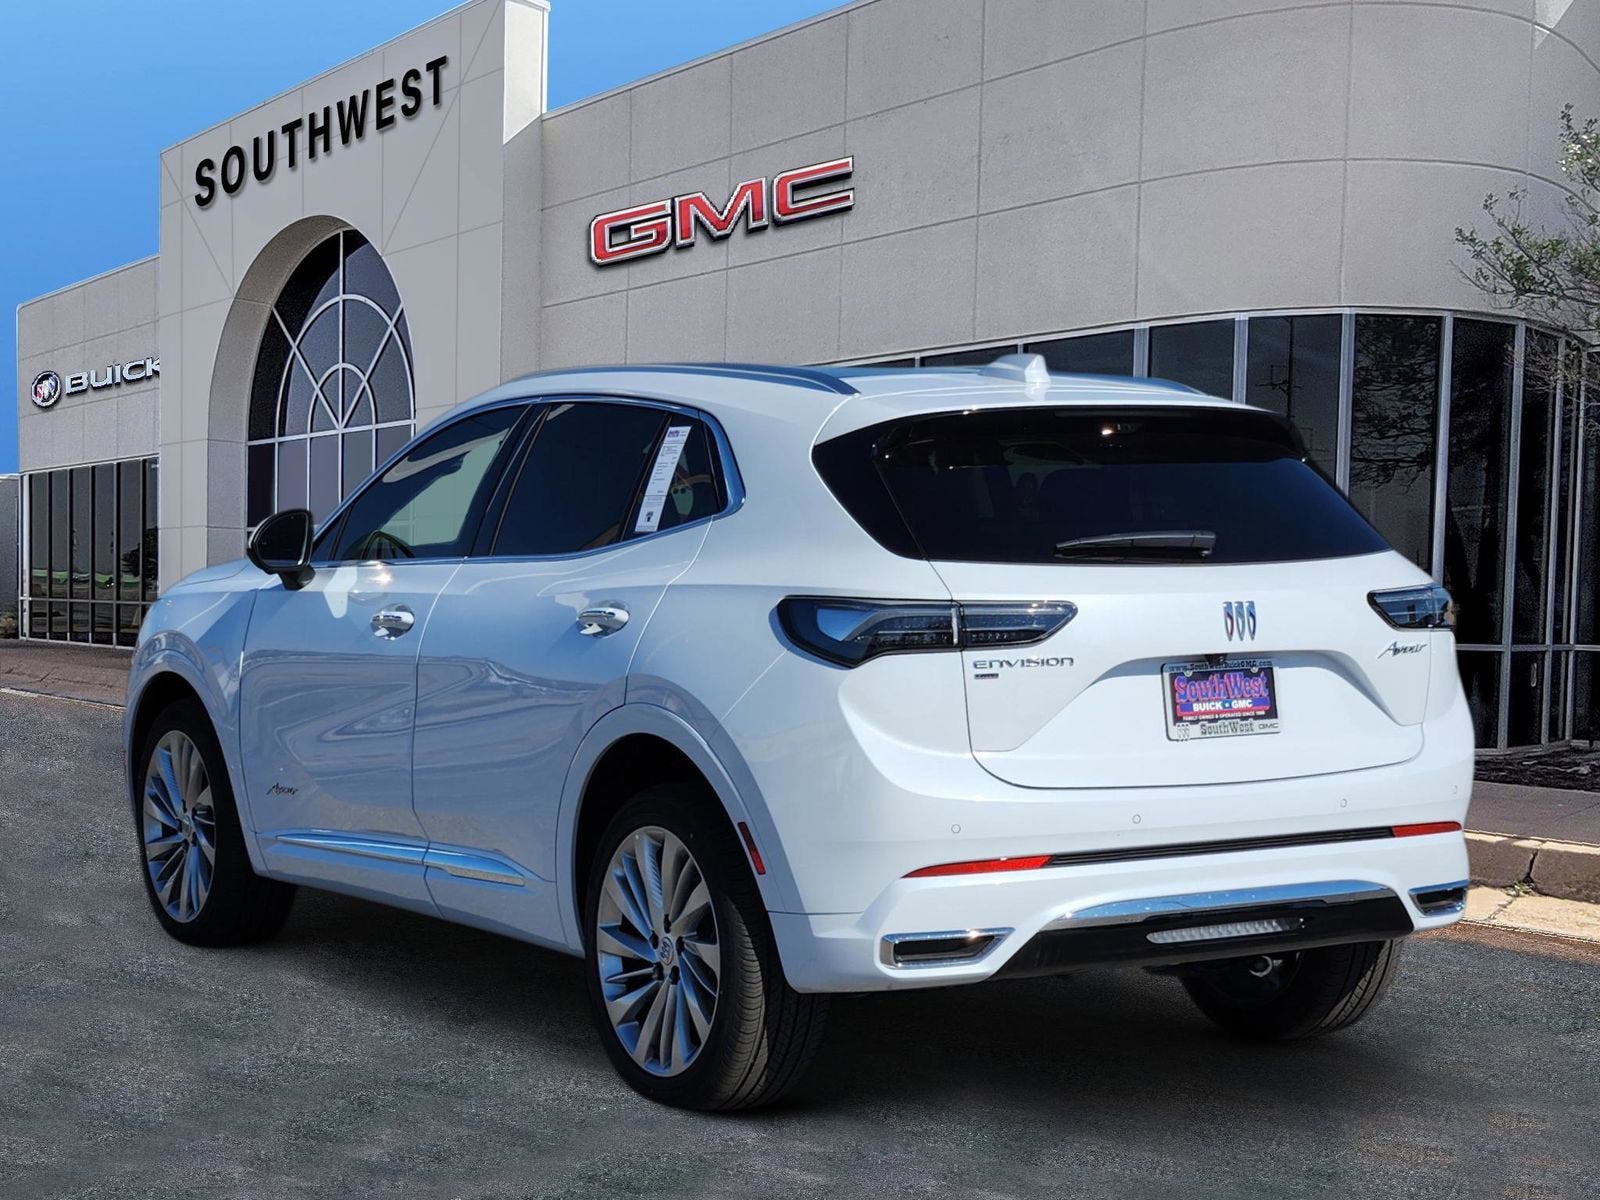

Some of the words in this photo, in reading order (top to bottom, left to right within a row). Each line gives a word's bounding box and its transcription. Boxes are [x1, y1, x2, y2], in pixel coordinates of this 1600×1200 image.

[194, 55, 448, 207] SOUTHWEST
[589, 155, 855, 265] GMC
[64, 357, 160, 395] BUICK
[973, 657, 1074, 669] ENVISION
[1175, 672, 1268, 702] SouthWest
[1192, 701, 1223, 712] BUICK
[1231, 699, 1253, 709] GMC
[1200, 719, 1254, 735] SouthWest
[1258, 722, 1279, 730] GMC
